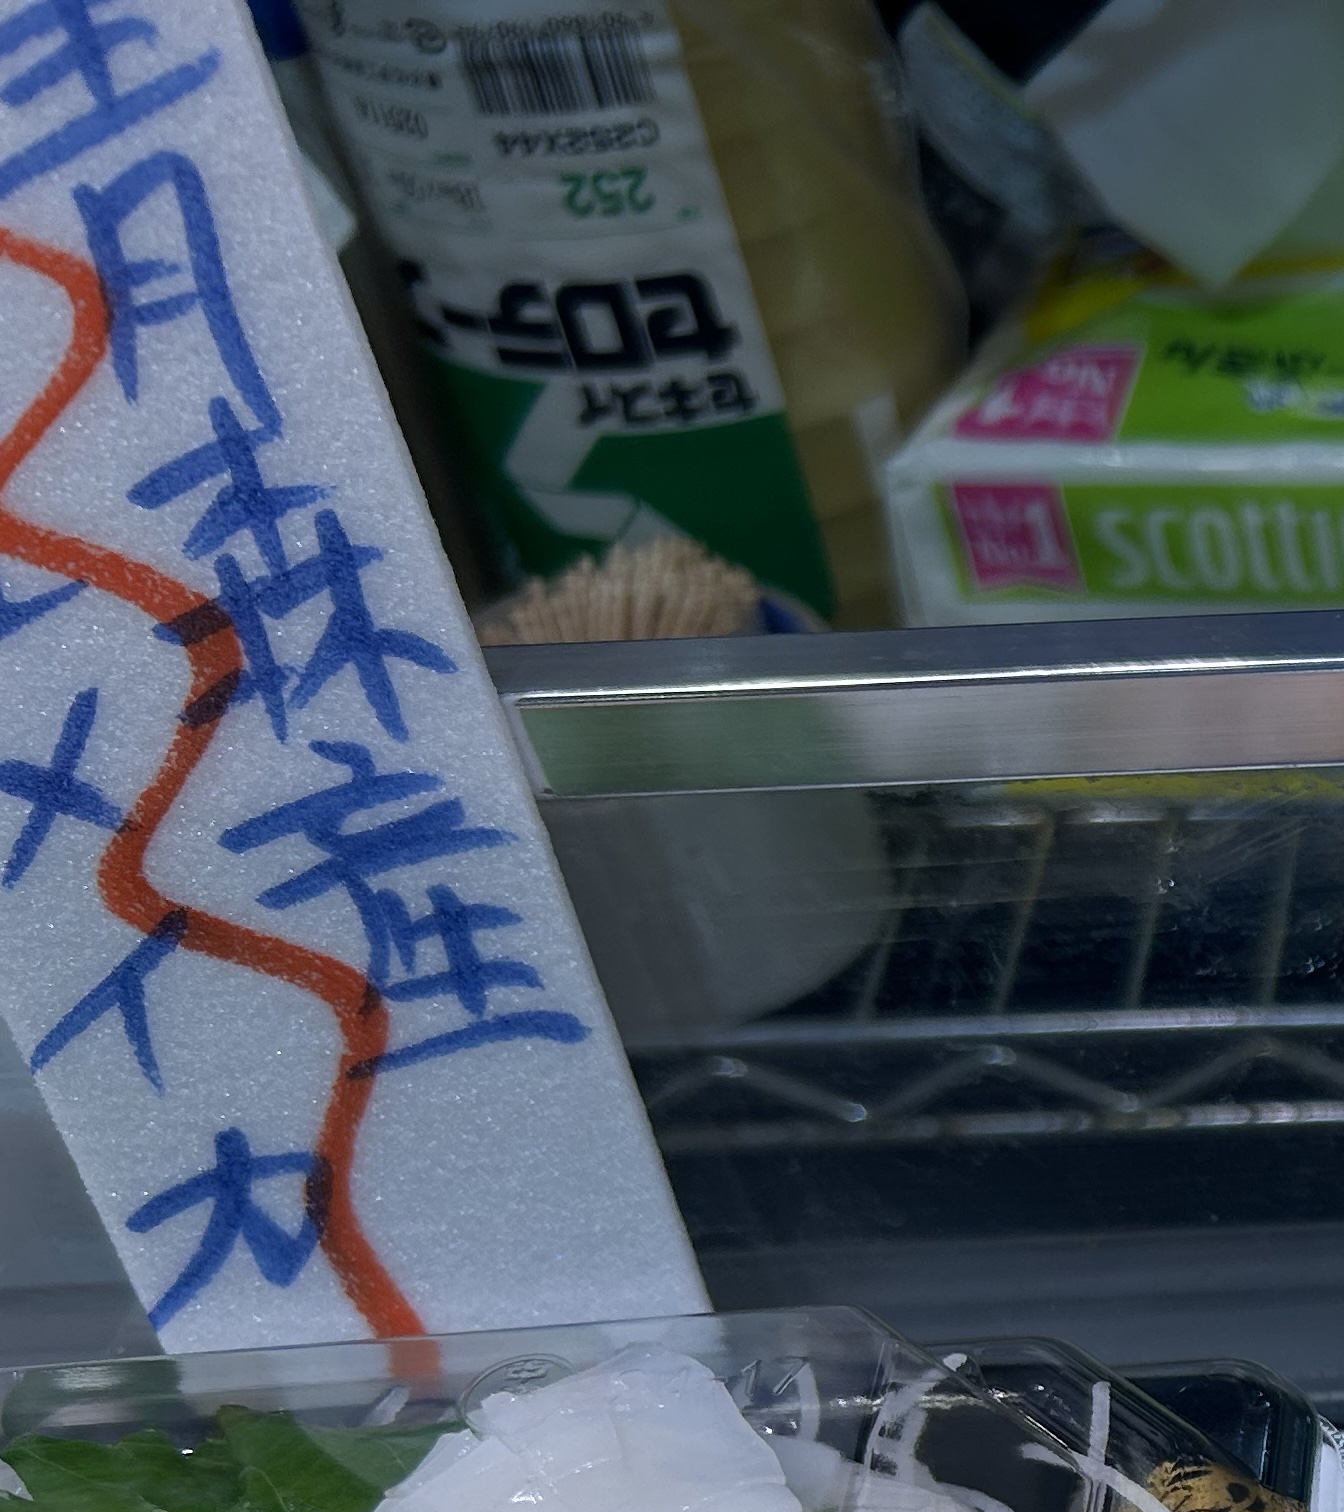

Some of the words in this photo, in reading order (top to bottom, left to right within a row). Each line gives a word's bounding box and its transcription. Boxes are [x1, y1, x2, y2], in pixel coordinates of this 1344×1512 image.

[558, 165, 655, 221] 252
[575, 367, 762, 429] セキスイ
[0, 580, 334, 1332] メイカ
